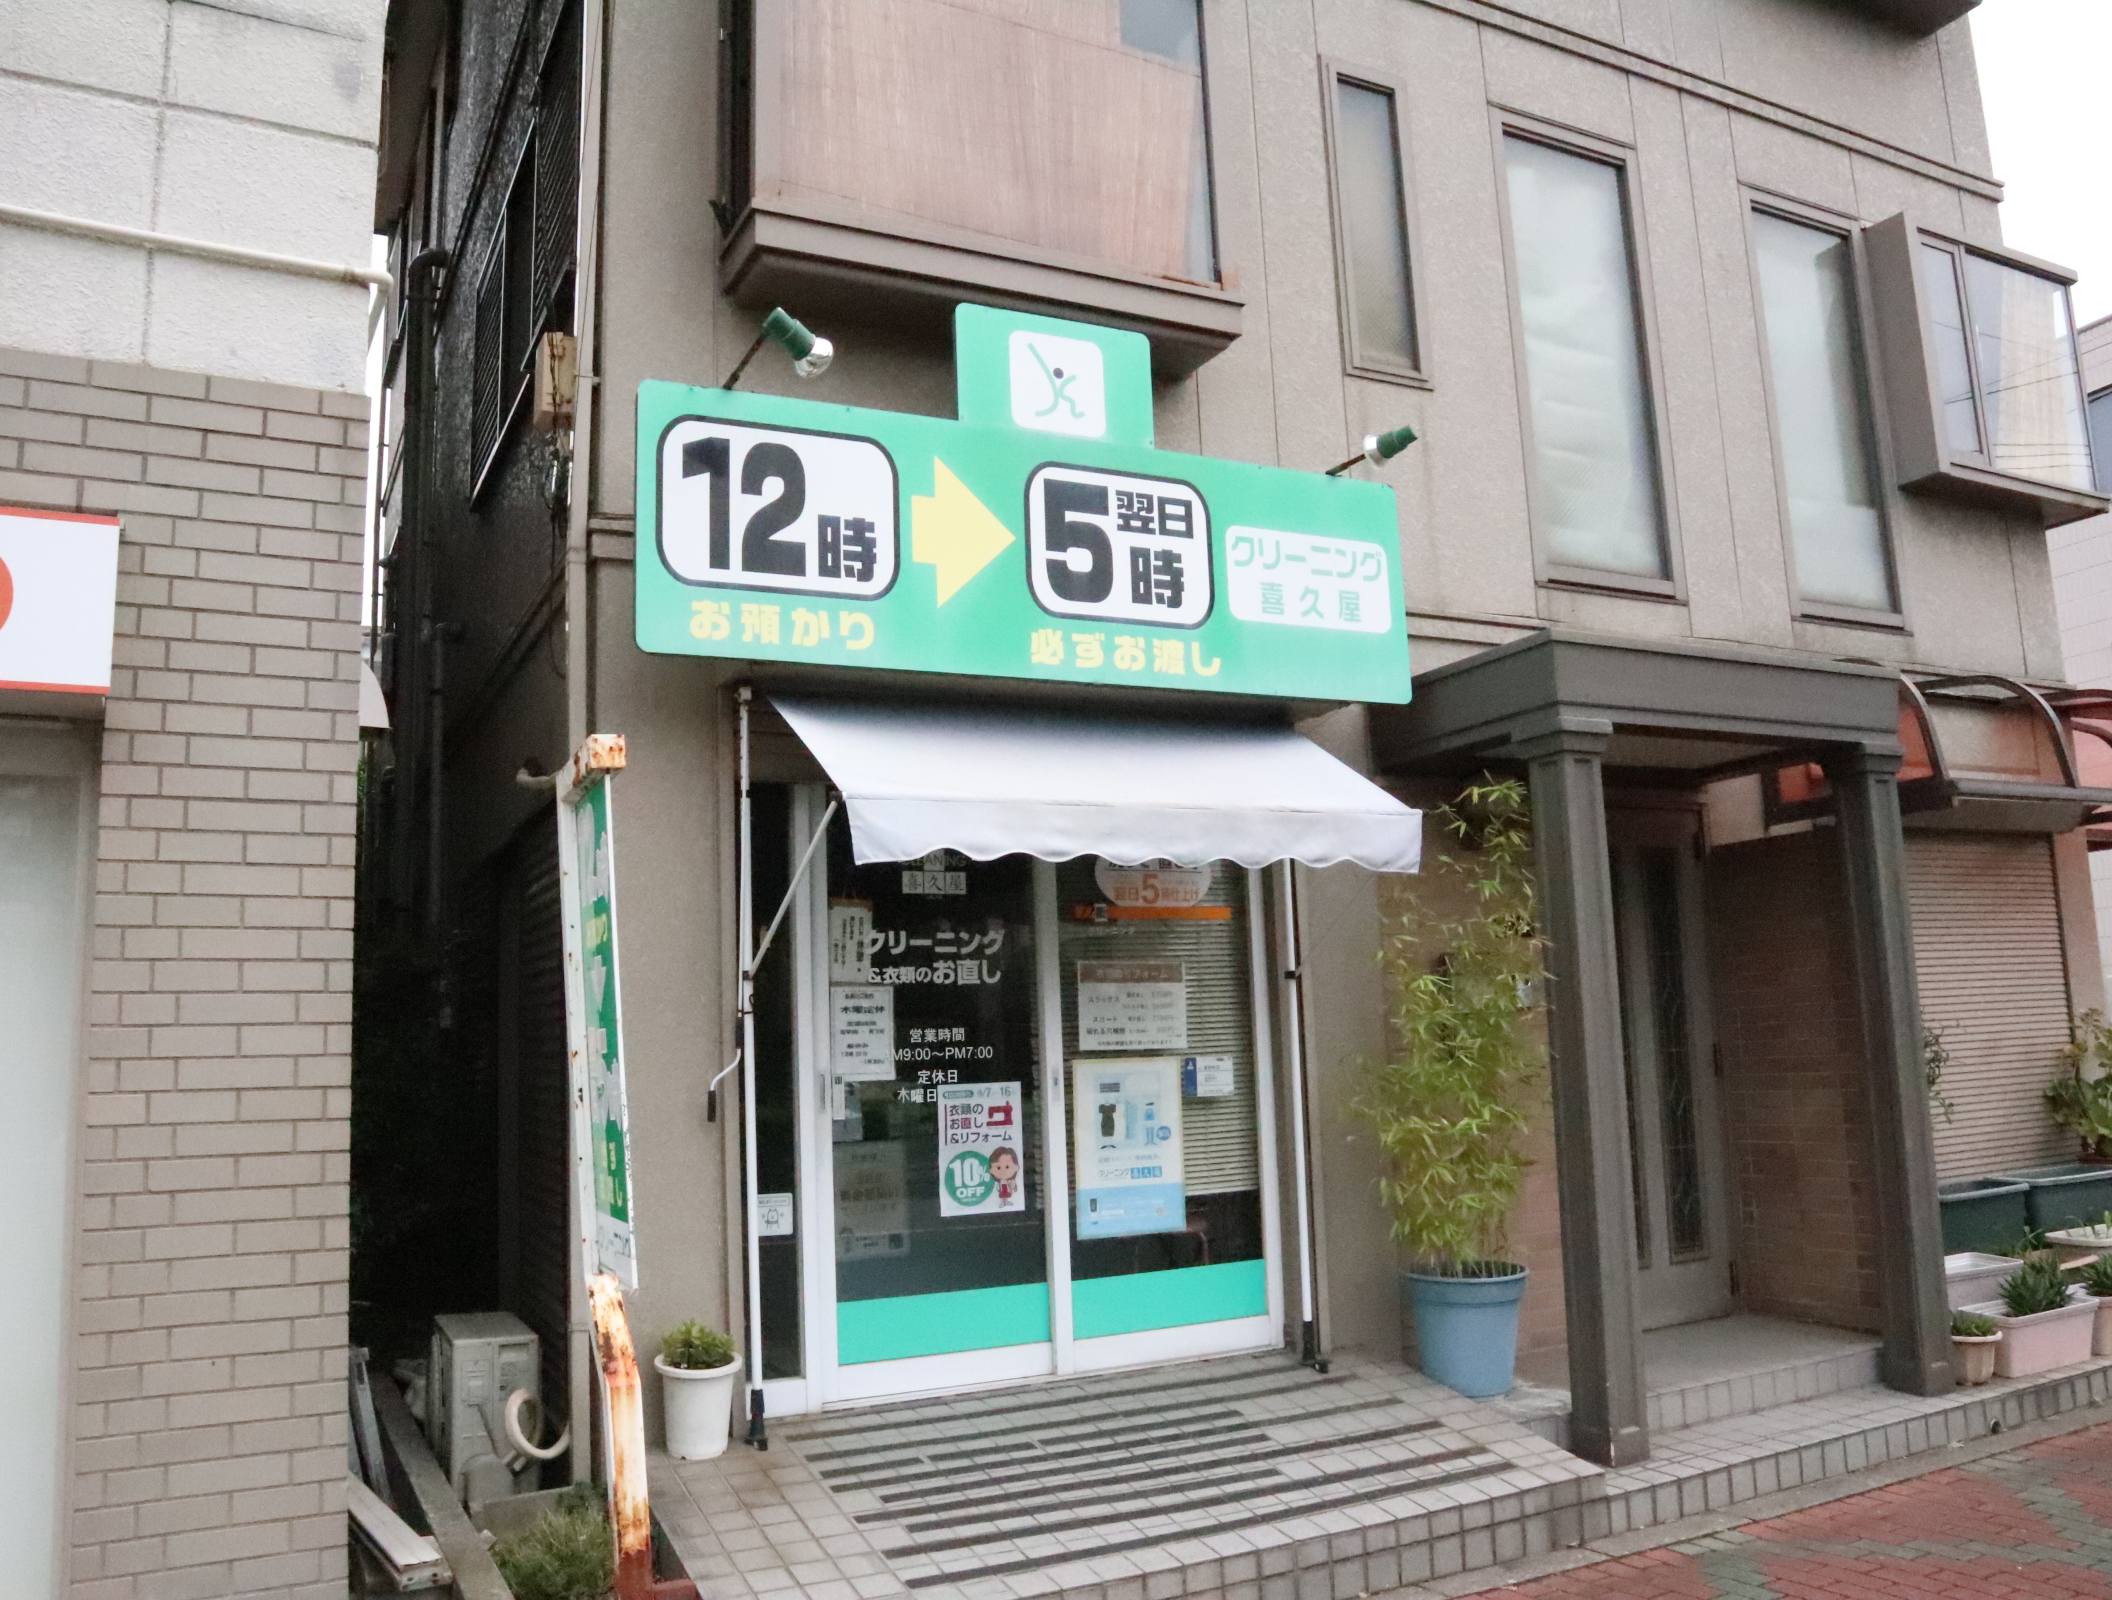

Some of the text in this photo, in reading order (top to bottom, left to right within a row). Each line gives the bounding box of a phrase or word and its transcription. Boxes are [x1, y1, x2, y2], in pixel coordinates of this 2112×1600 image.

[682, 436, 877, 583] 12時
[1115, 489, 1194, 539] 翌日
[1231, 535, 1382, 582] クリーニング
[1260, 581, 1362, 623] 喜久屋
[689, 600, 875, 650] お預かり
[1030, 628, 1222, 677] 必ずお渡し
[903, 872, 965, 893] 喜久屋
[864, 930, 1005, 955] クリーニング
[867, 959, 1002, 985] &衣類のお直し
[909, 1027, 966, 1043] 営業時間
[918, 1069, 958, 1084] 定休日
[897, 1087, 937, 1103] 木曜日
[949, 1103, 984, 1116] 衣類の
[949, 1117, 984, 1130] お直し
[950, 1130, 1013, 1144] &リフォーム
[949, 1157, 991, 1188] 10%
[956, 1186, 985, 1198] OFF
